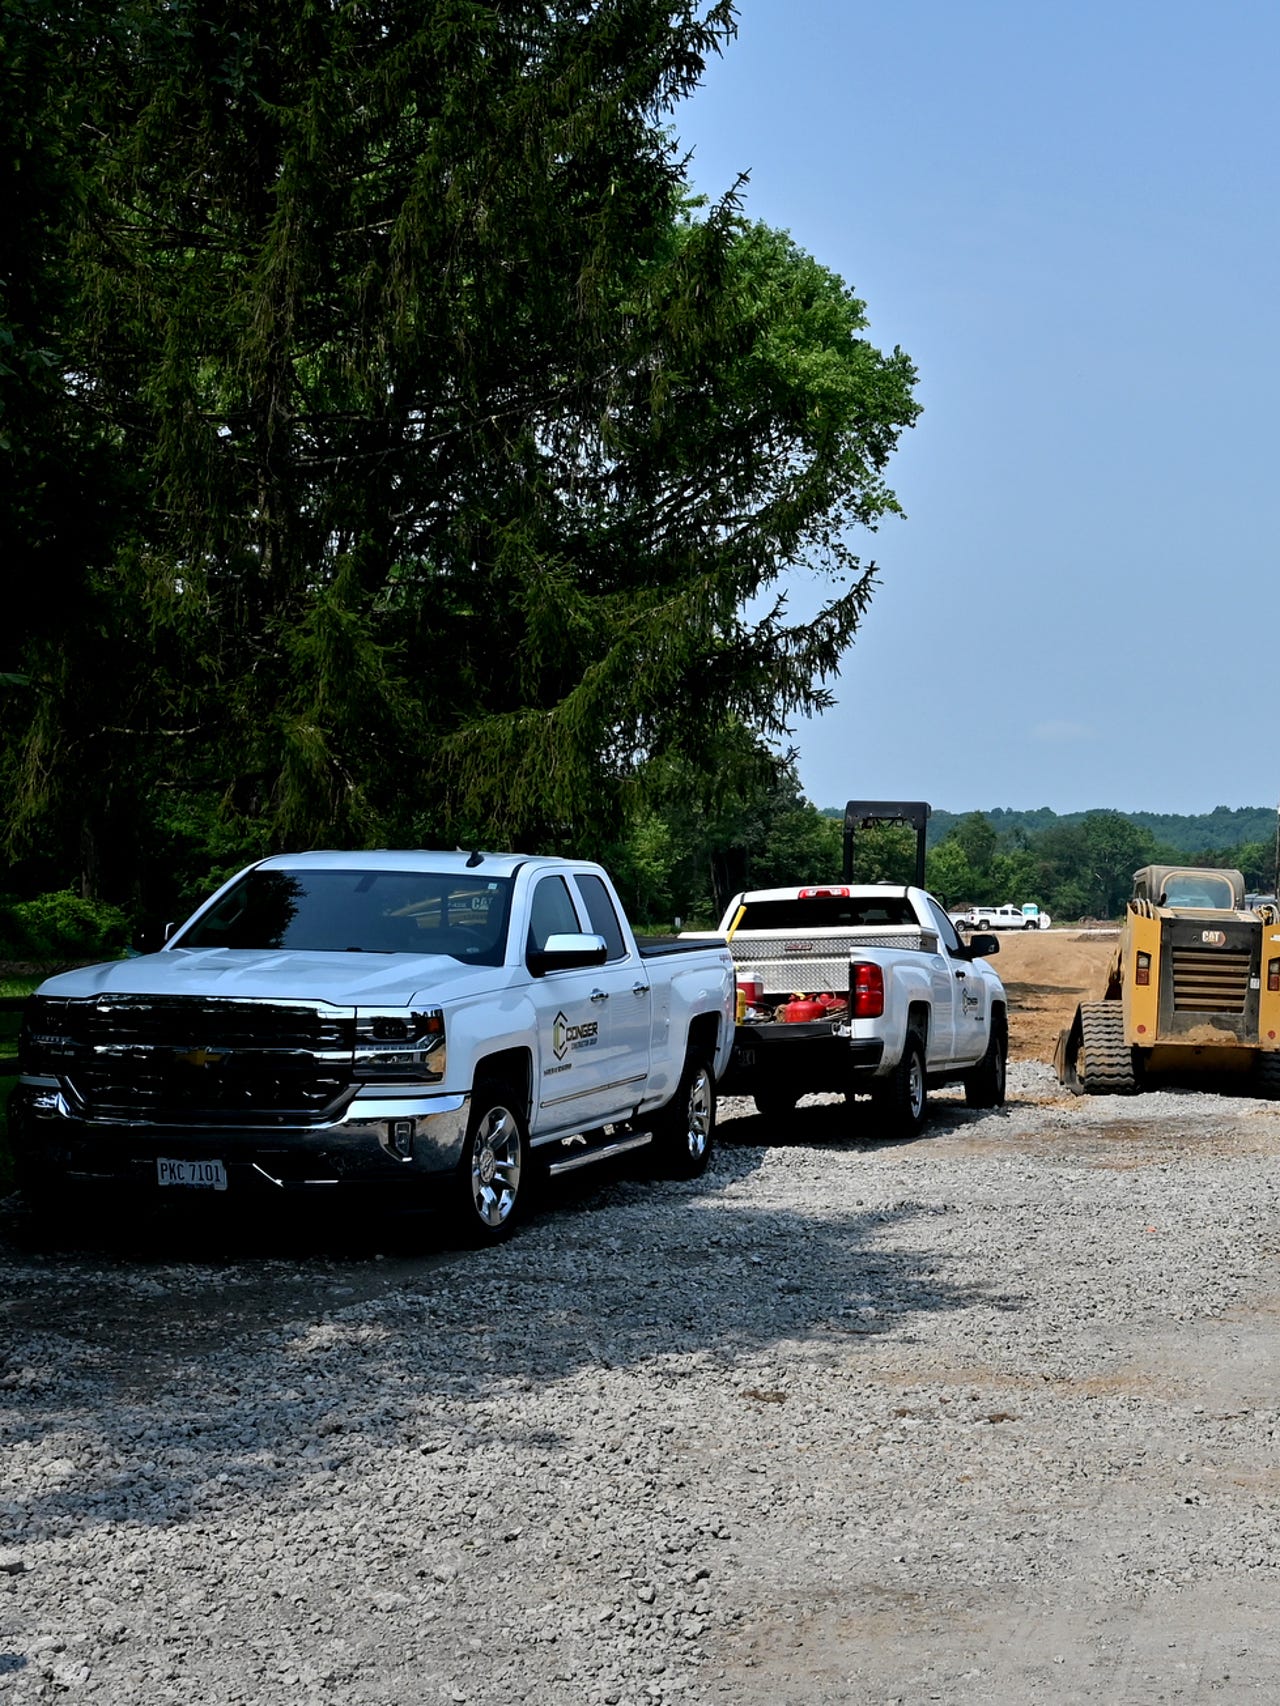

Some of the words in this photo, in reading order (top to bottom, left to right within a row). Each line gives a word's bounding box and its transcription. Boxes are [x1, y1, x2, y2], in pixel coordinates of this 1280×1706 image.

[1202, 930, 1220, 943] CAT
[160, 1162, 184, 1181] PKC
[189, 1163, 221, 1182] 7101
